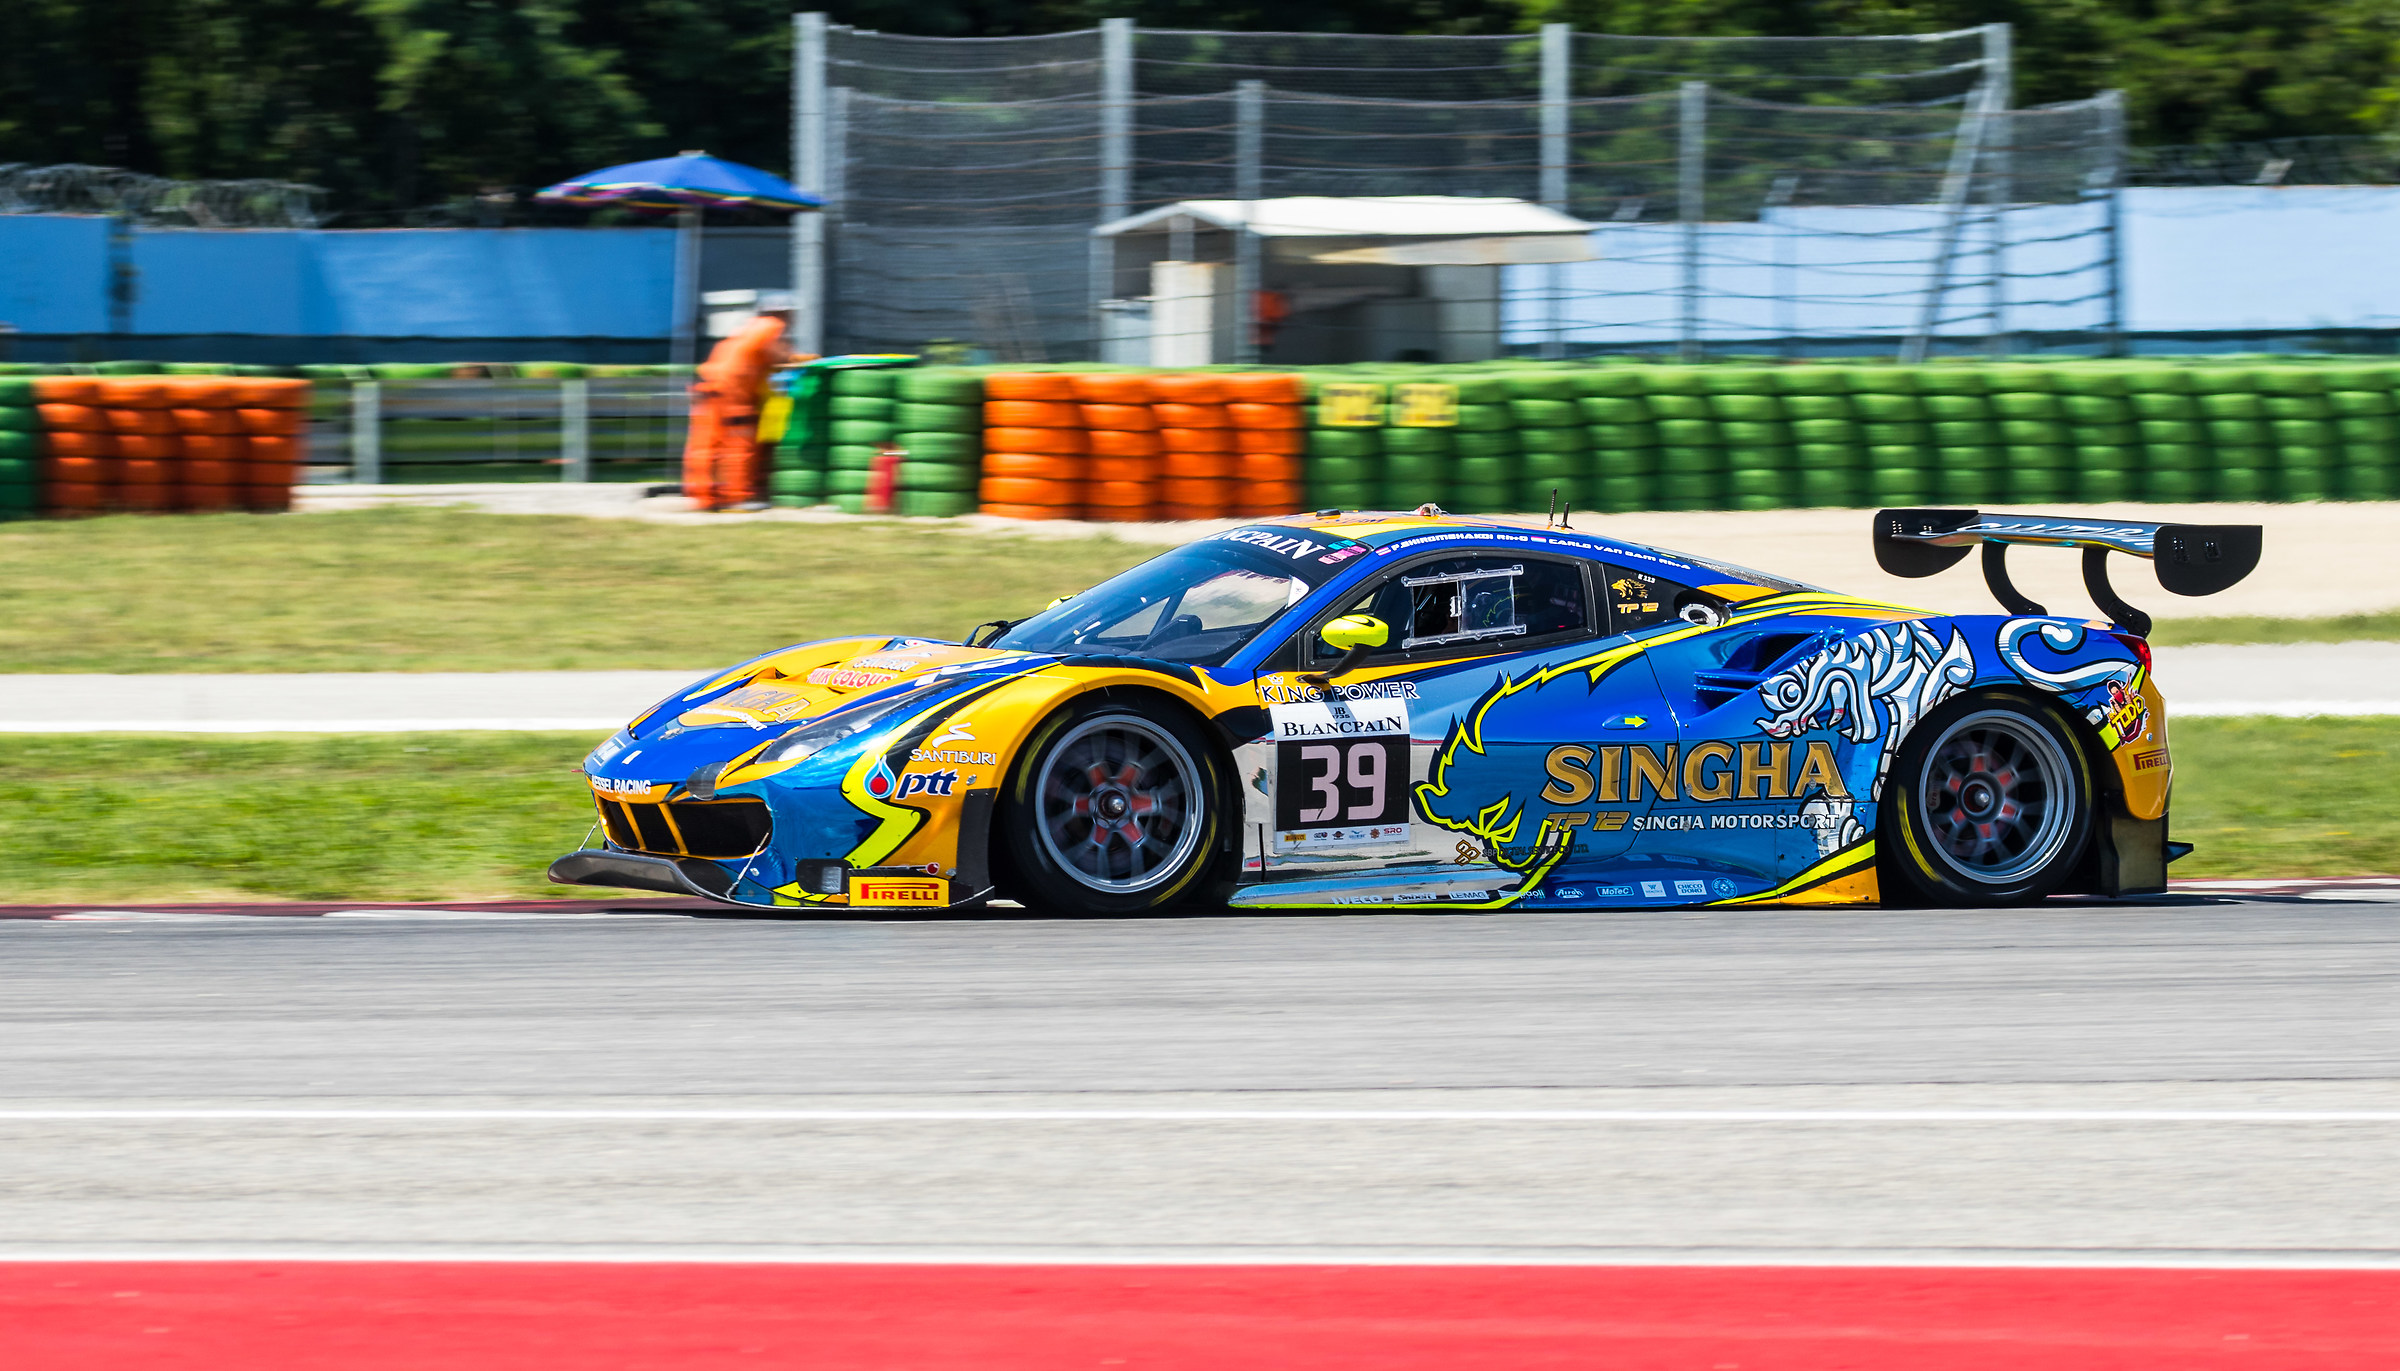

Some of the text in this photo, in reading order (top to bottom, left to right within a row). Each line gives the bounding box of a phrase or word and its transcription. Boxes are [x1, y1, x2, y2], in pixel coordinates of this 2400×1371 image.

[1549, 538, 1592, 549] CARLO
[1617, 603, 1639, 614] TP
[1260, 681, 1421, 703] KING POWER
[1282, 716, 1403, 737] BLANCPAIN
[909, 748, 996, 766] SANTIBURI
[1300, 742, 1387, 823] 39
[1538, 741, 1854, 806] SINGHA
[614, 779, 652, 795] RACING
[895, 768, 959, 800] ptt
[1547, 811, 1631, 833] TP 12
[1632, 813, 1840, 832] SINGHA MOTORSPORT
[861, 883, 940, 901] PIRELLI
[1331, 895, 1383, 905] IVECO
[1601, 886, 1630, 896] MoTeC
